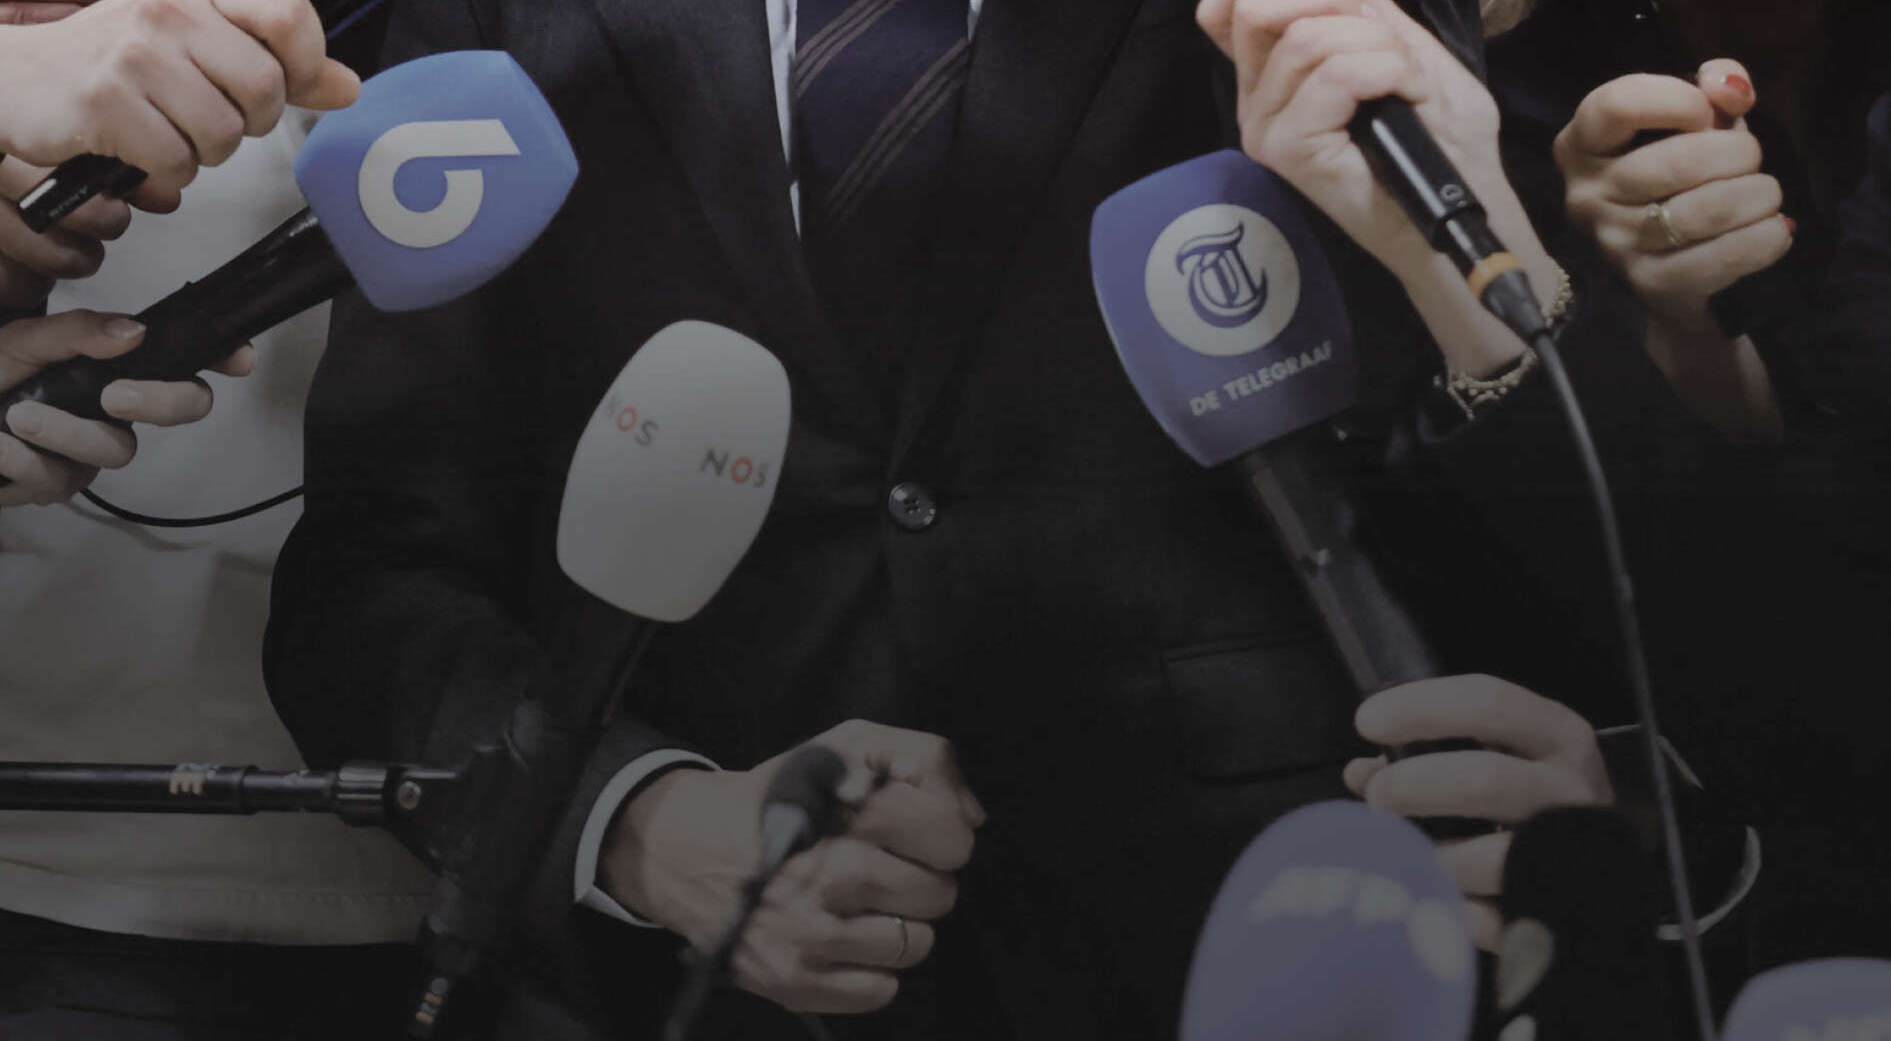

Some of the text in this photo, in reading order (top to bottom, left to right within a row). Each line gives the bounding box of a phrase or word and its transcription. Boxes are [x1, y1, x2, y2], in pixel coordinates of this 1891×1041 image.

[1189, 340, 1333, 417] DE TELEGRAAF
[700, 448, 769, 489] NOS
